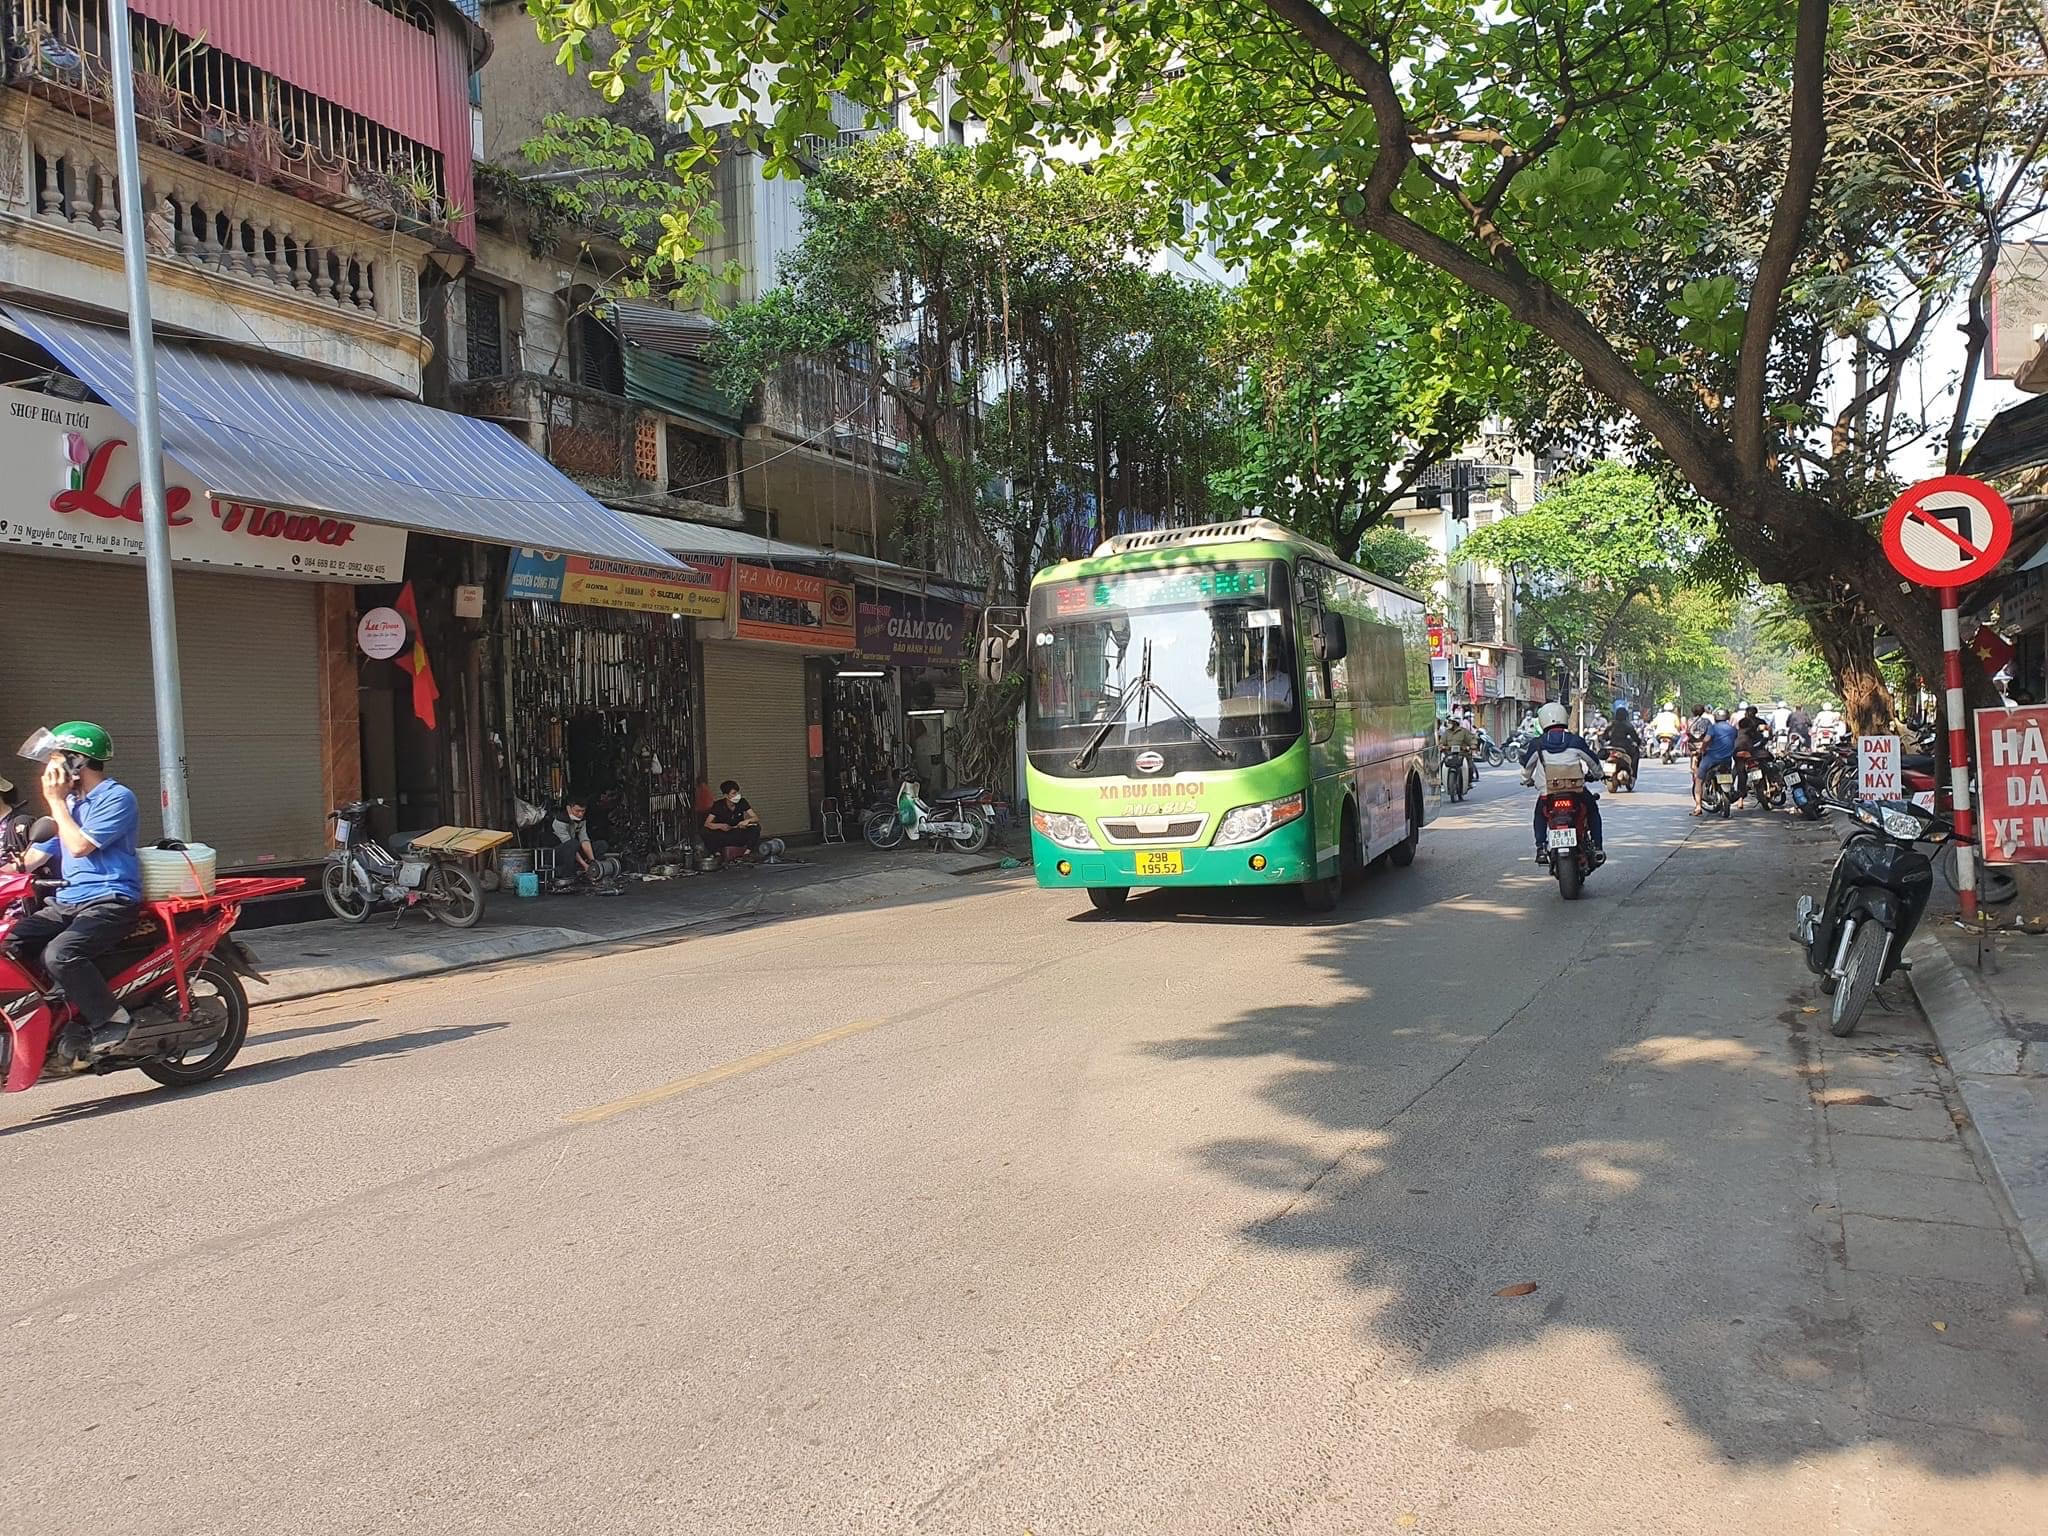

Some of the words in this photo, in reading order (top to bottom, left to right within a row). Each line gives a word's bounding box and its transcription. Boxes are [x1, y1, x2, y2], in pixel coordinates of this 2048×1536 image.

[10, 402, 39, 419] SHOP
[41, 408, 62, 424] HOA
[13, 525, 23, 535] 79
[26, 526, 55, 539] Nguyễn
[57, 530, 77, 543] Công
[96, 535, 108, 544] Hai
[586, 583, 608, 591] HONDA
[657, 590, 684, 600] SUZUKI
[698, 596, 721, 604] PIAGGIO
[887, 612, 925, 640] GIẢM
[926, 618, 953, 641] XÓC
[1868, 756, 1888, 770] XE
[1122, 784, 1148, 798] BUS
[1993, 818, 2025, 848] XE
[1149, 852, 1168, 863] 29B
[1142, 864, 1177, 874] 195.52
